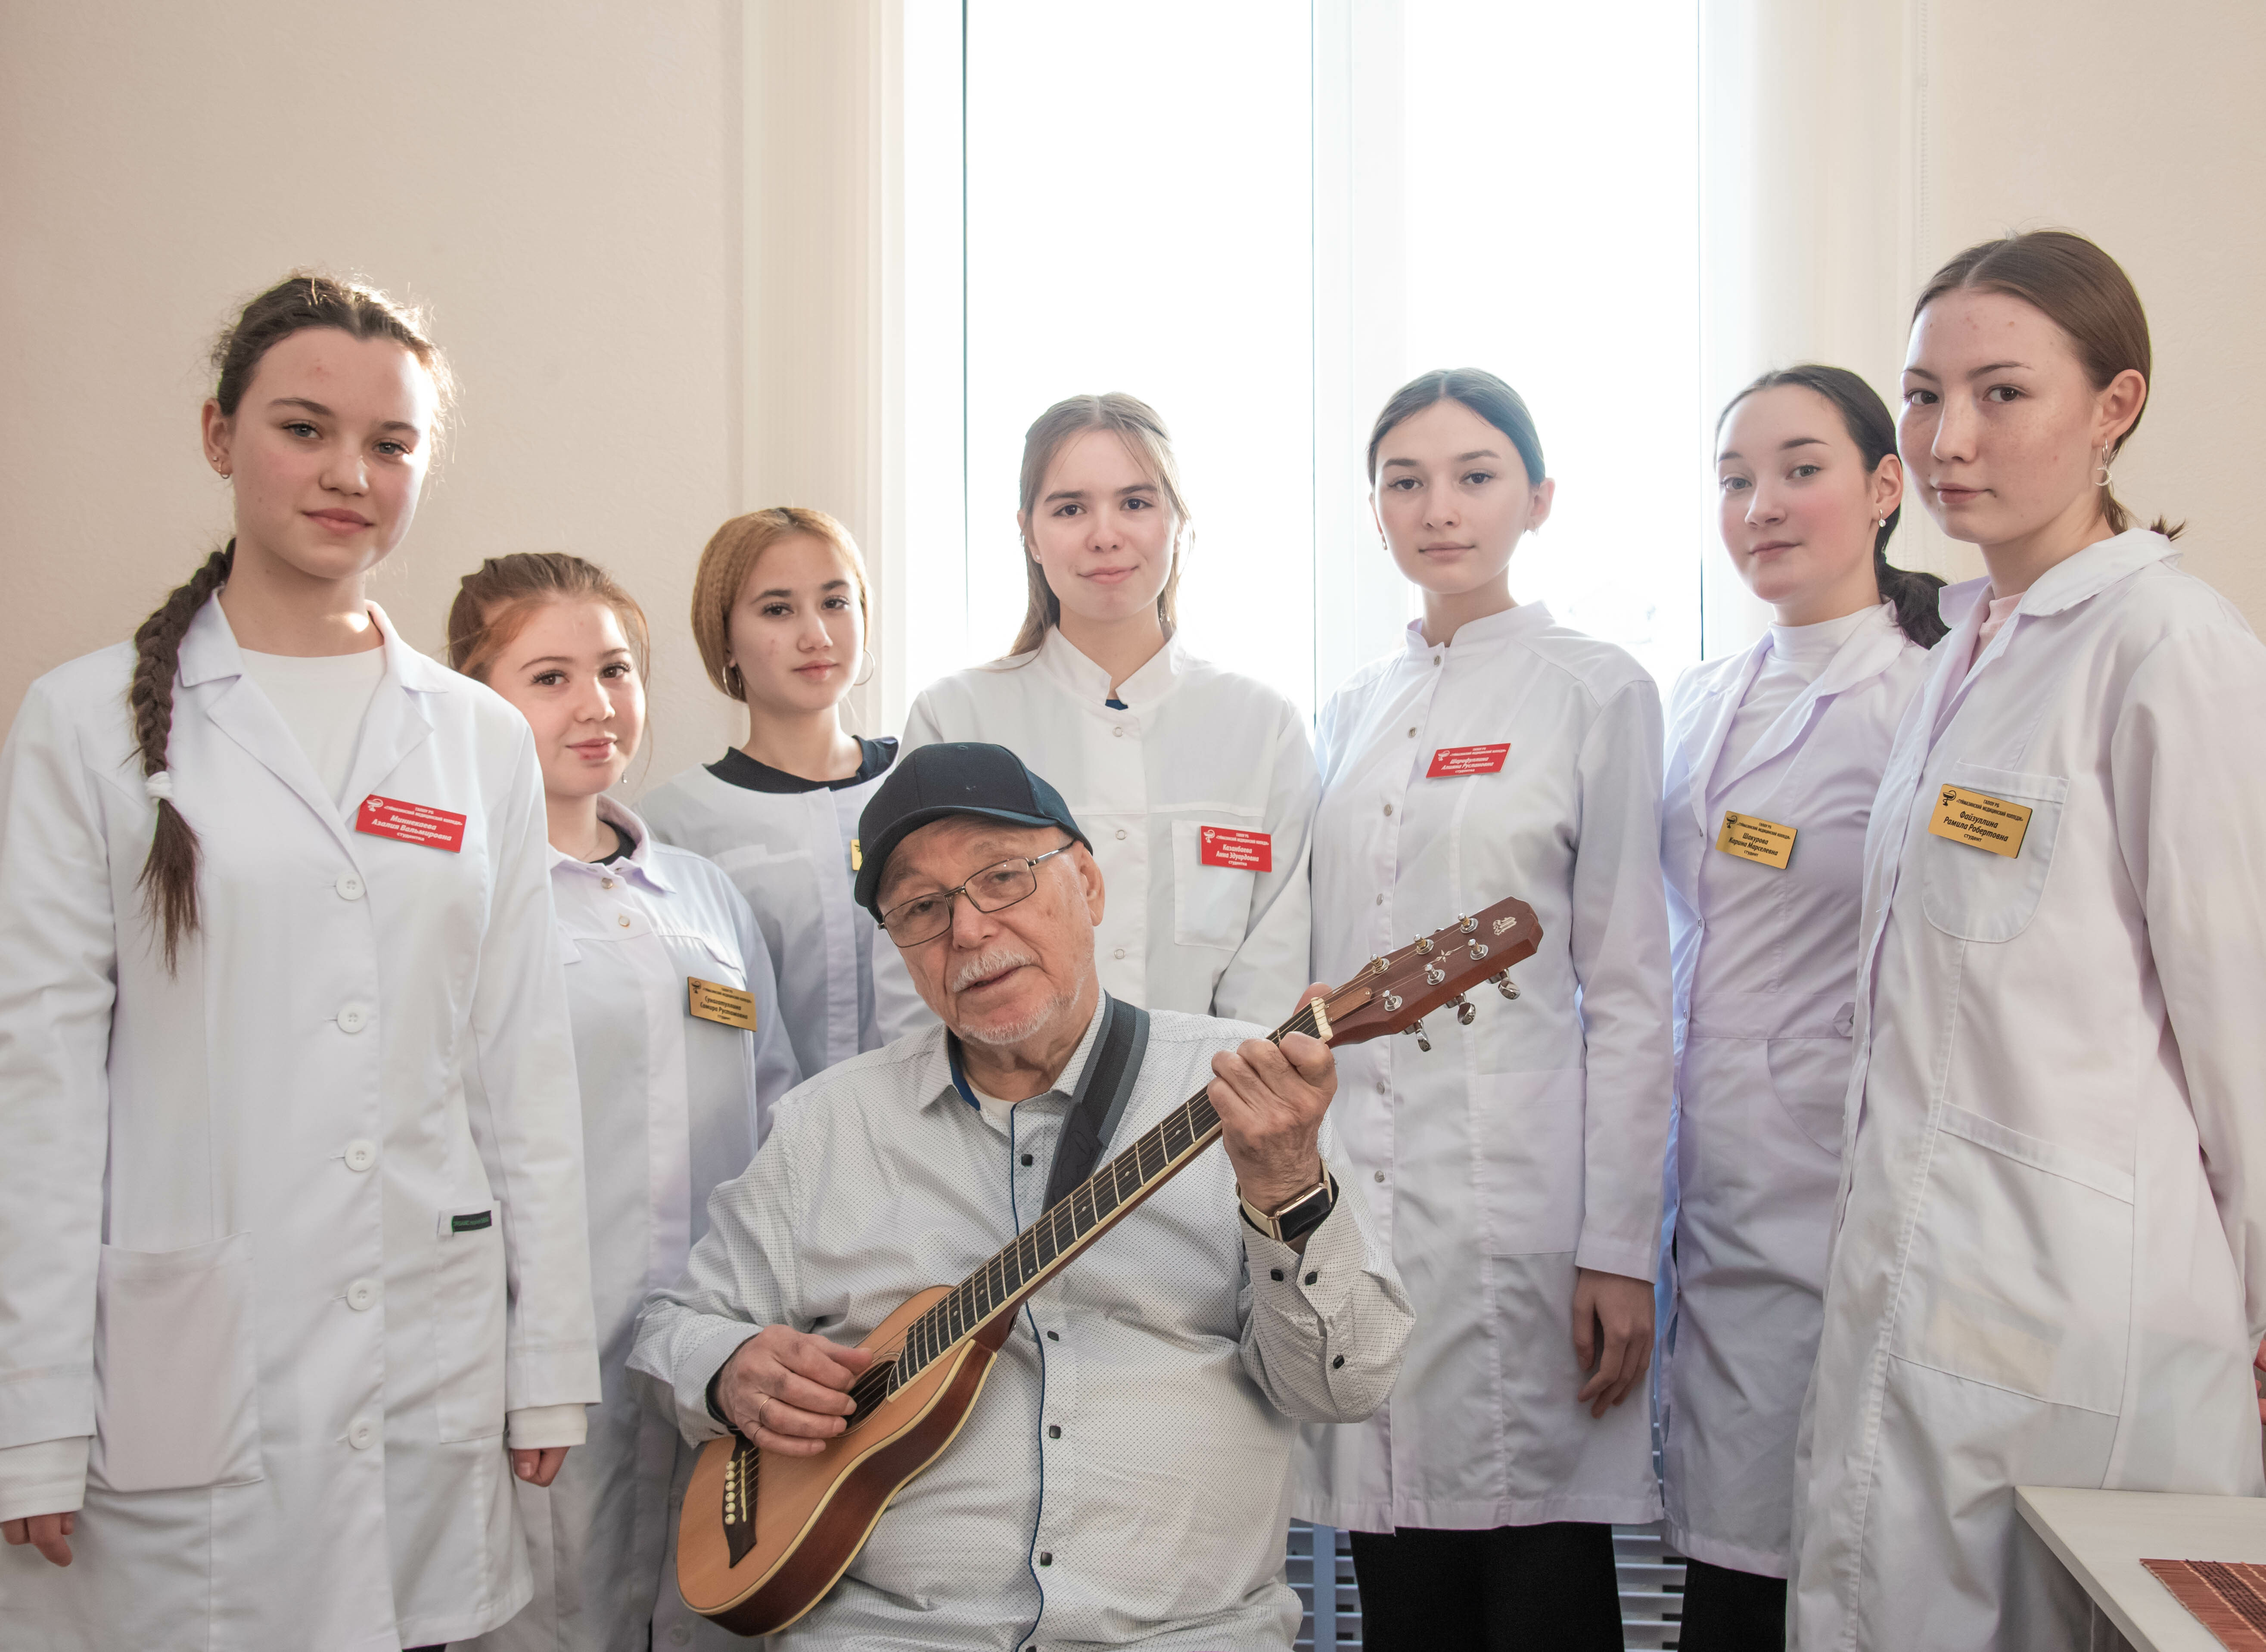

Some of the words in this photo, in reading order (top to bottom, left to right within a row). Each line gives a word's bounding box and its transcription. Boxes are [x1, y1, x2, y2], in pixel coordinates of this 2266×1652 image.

[390, 815, 437, 830] Миннекаева
[1960, 810, 1999, 829] Файзуллина
[371, 819, 399, 829] Азалия
[400, 824, 452, 841] Вальмировна
[1943, 816, 1968, 830] Рамила
[1968, 824, 2009, 842] Робертовна
[397, 832, 425, 841] студентка
[1742, 832, 1769, 845] Шакурова
[1964, 834, 1982, 842] студент
[1223, 844, 1253, 854] Казанбаева
[1728, 837, 1747, 847] Карина
[1747, 842, 1778, 856] Марселевна
[1229, 853, 1259, 862] Эдуардовна
